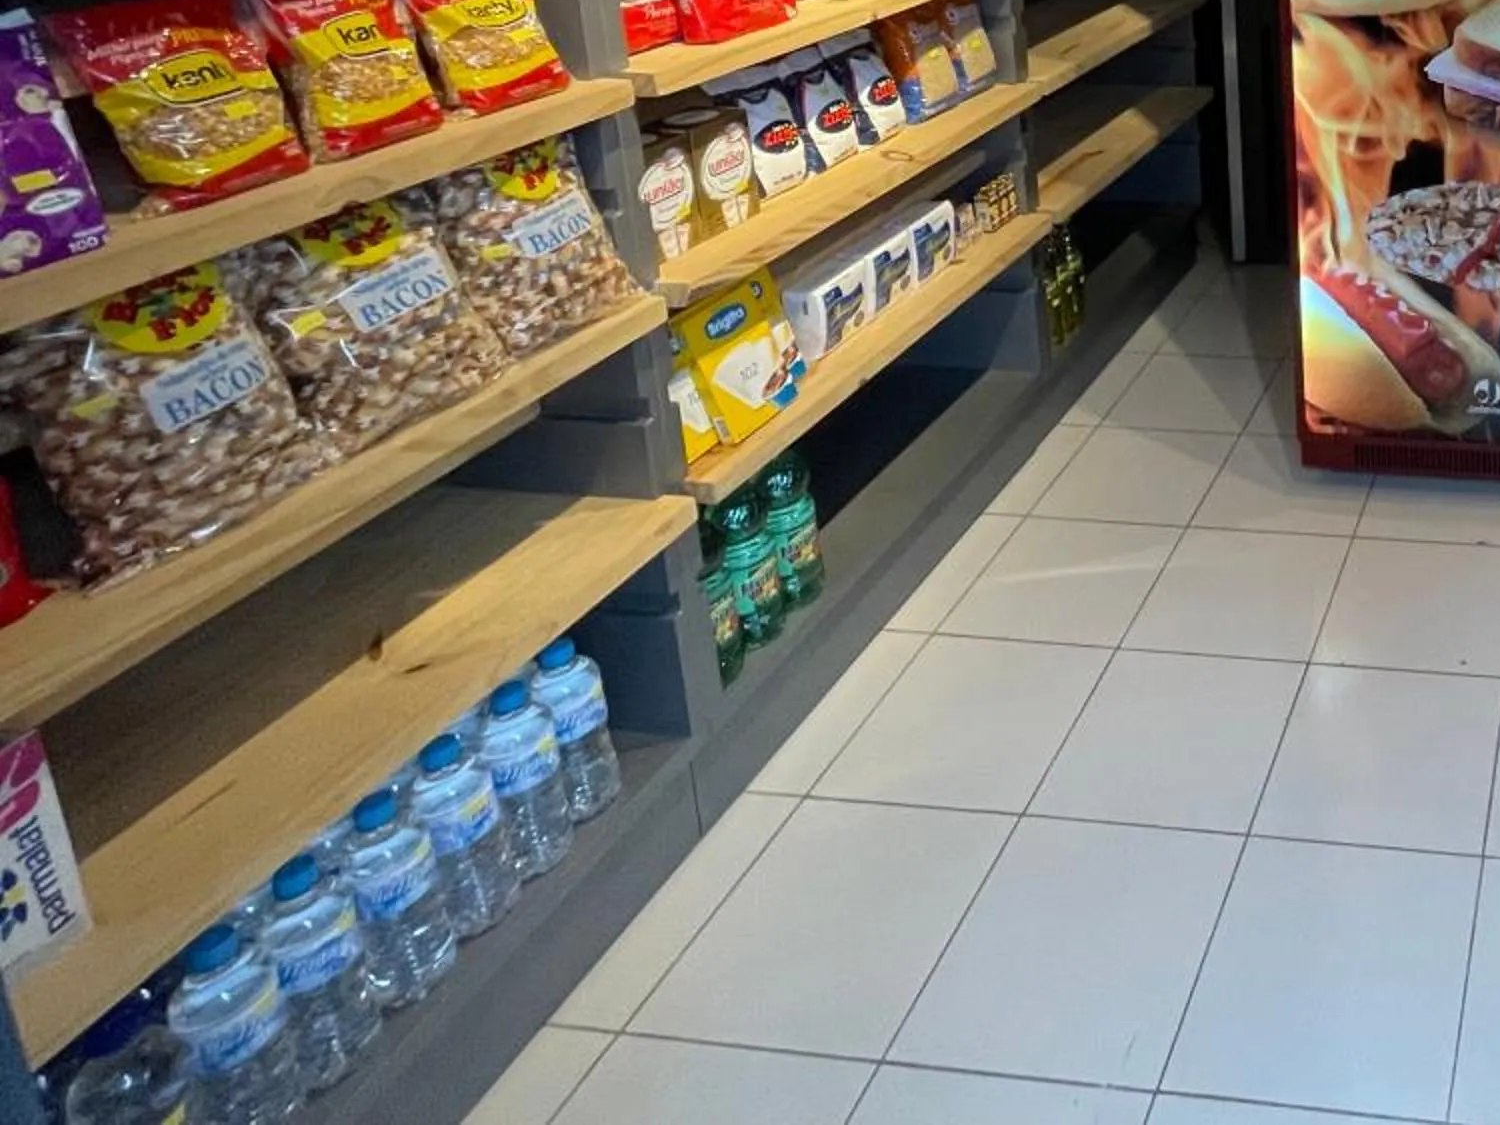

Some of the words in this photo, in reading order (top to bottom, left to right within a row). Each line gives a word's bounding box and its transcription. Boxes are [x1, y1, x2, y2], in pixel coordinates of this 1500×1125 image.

[528, 211, 591, 254] BACON
[360, 272, 450, 326] BACON
[163, 355, 267, 424] BACON
[8, 814, 77, 935] parmalat
